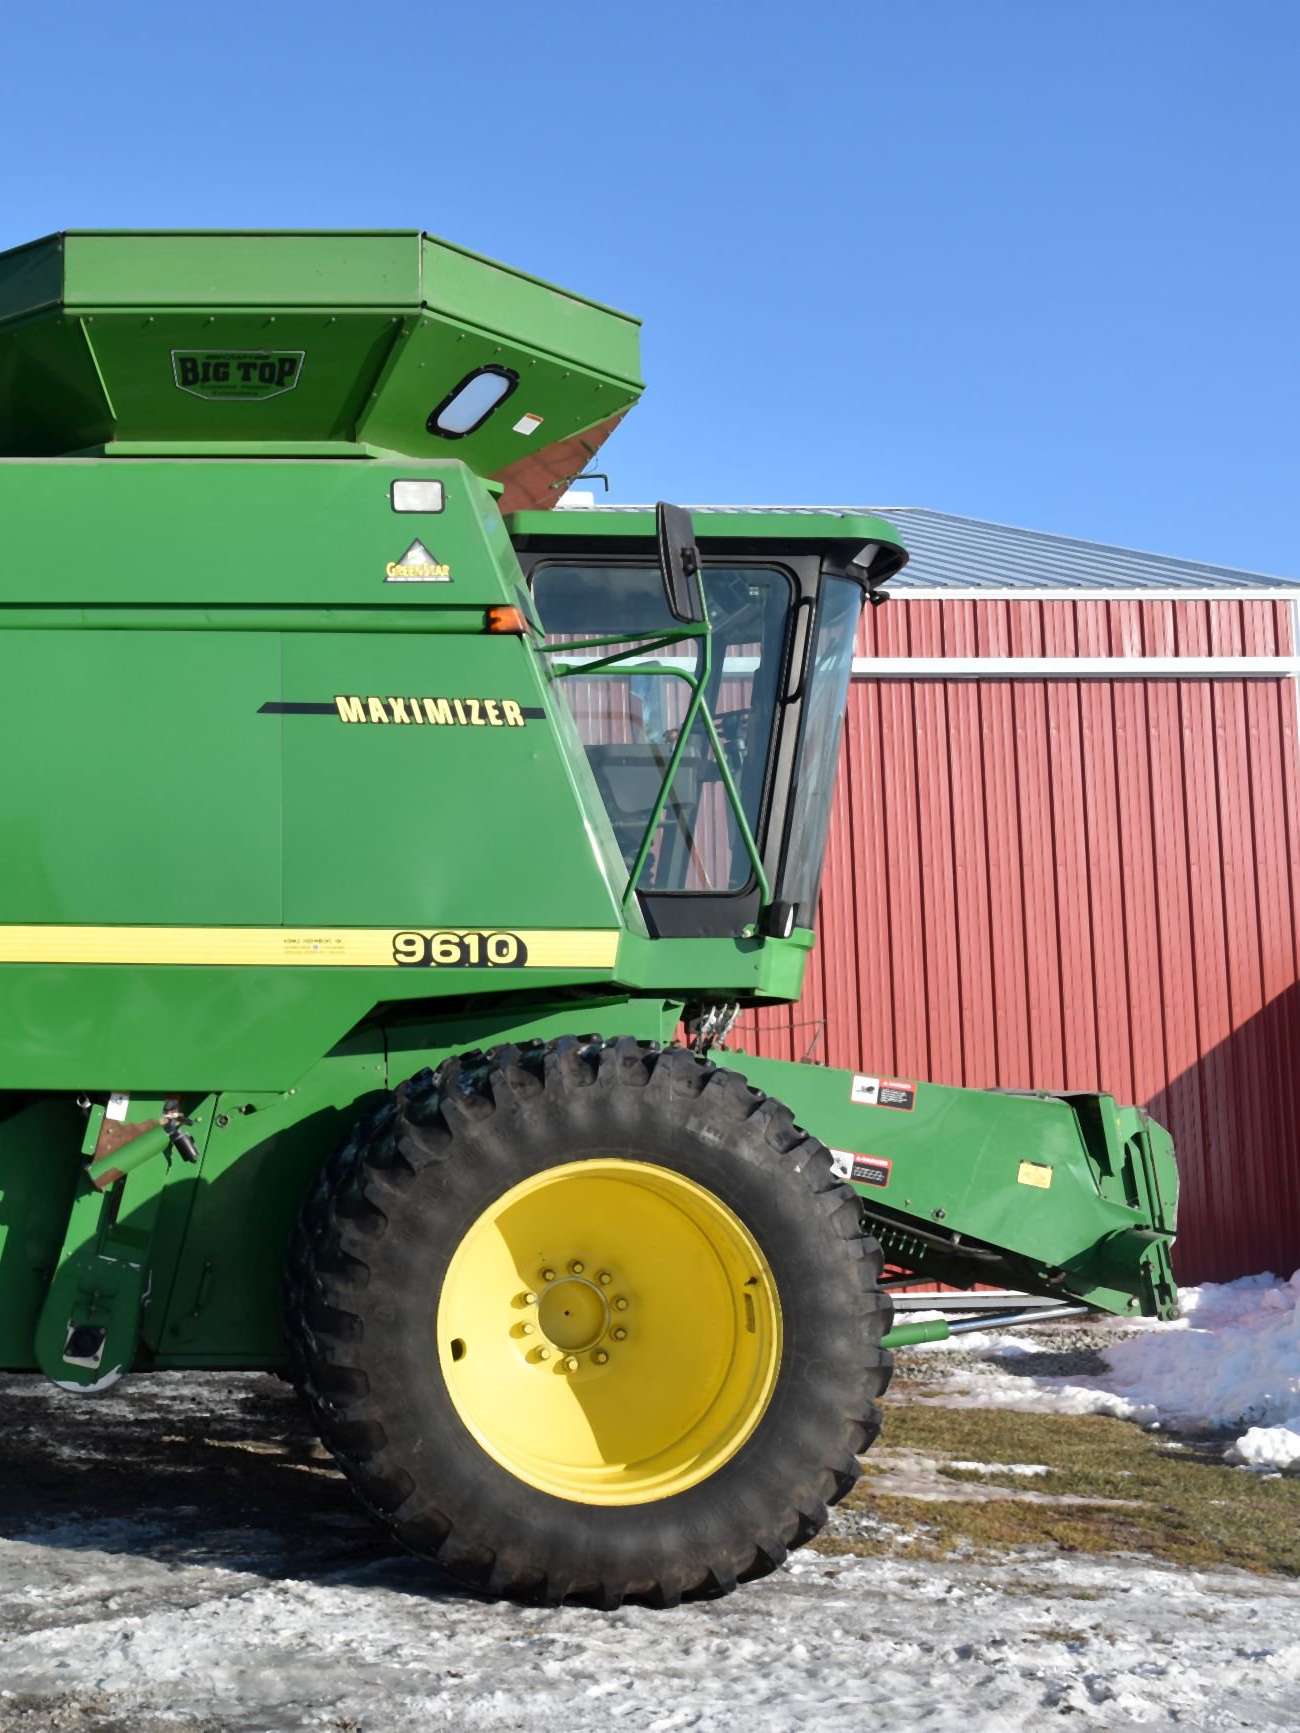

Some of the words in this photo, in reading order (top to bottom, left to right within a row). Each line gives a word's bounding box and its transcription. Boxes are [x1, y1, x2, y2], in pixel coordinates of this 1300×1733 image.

[179, 357, 230, 386] BIG
[237, 358, 297, 386] TOP
[334, 695, 525, 727] MAXIMIZER
[392, 931, 528, 967] 9610
